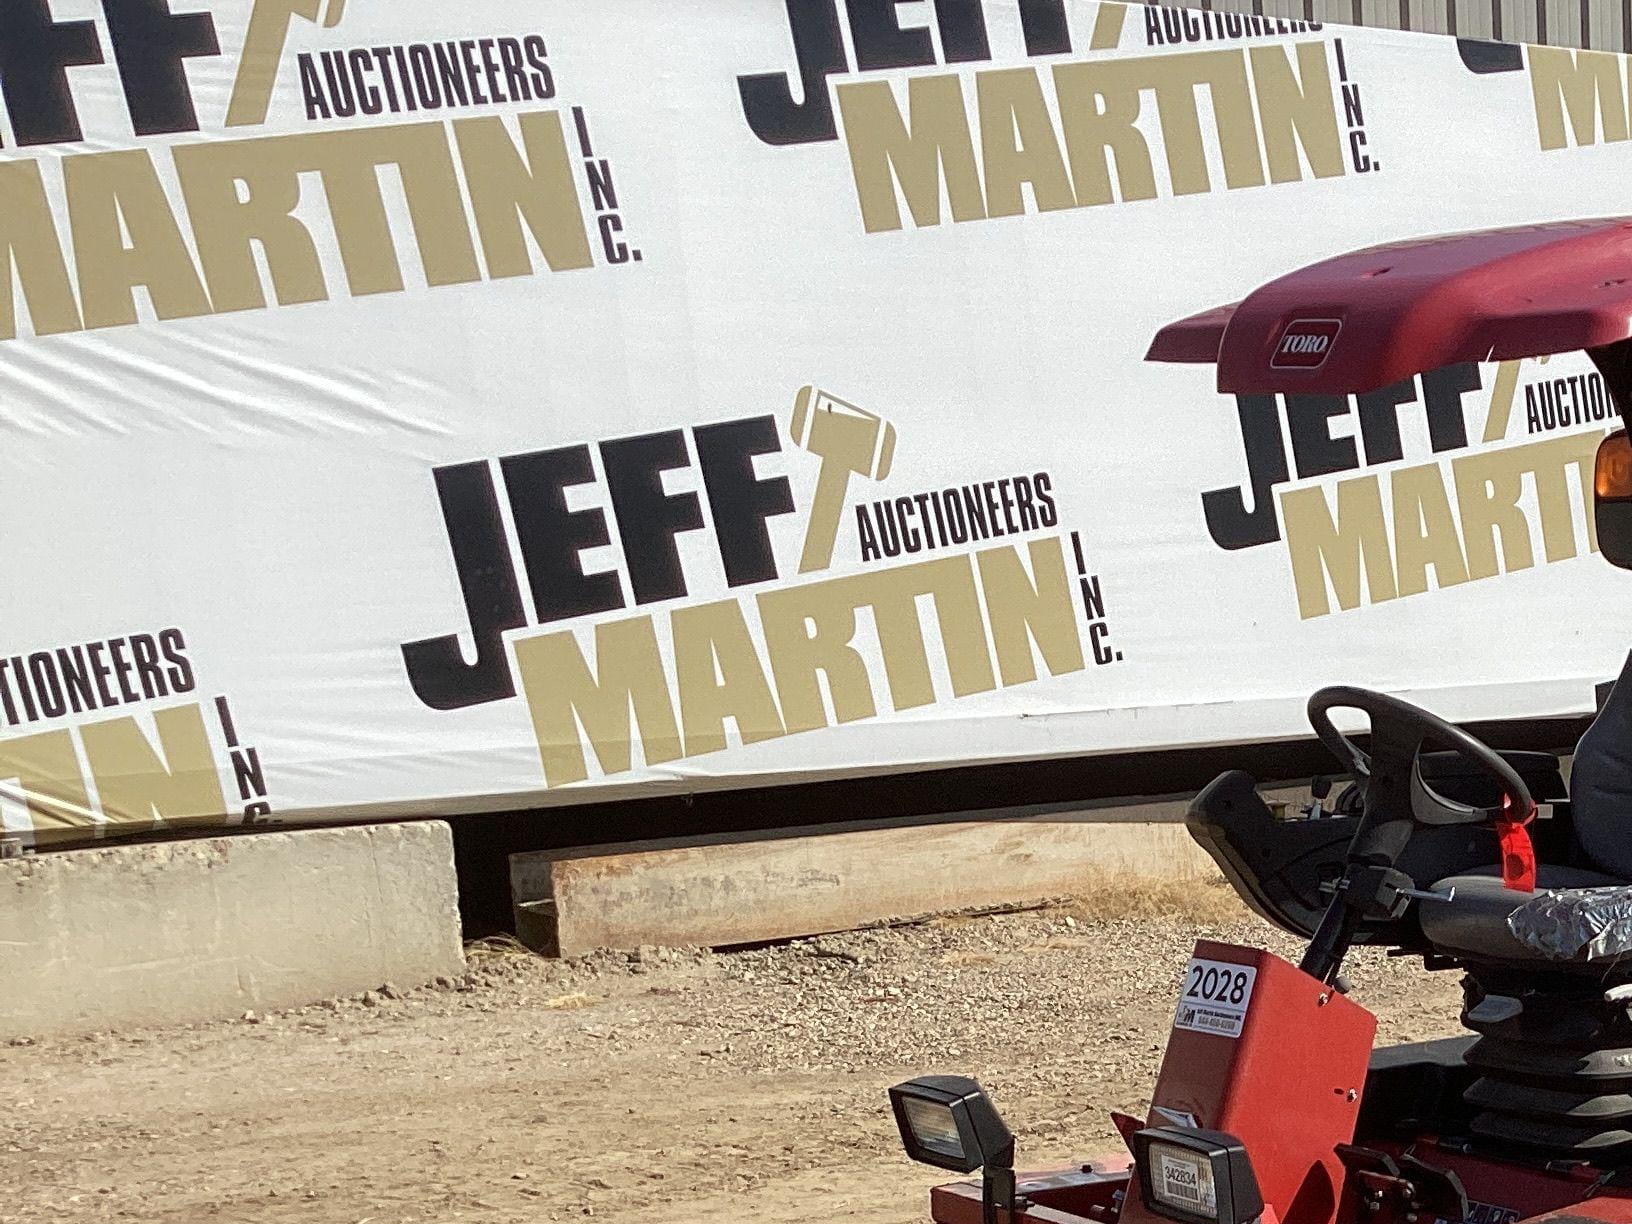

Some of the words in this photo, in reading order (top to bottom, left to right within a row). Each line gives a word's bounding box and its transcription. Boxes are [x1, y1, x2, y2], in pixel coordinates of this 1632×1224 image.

[0, 0, 221, 148] FF
[298, 35, 555, 120] AUCTIONEERS
[836, 40, 1346, 234] MARTIN
[1333, 38, 1381, 174] INC.
[572, 106, 643, 265] INC.
[1281, 334, 1329, 353] TORO
[400, 414, 797, 711] JEFF
[855, 472, 1057, 562] AUCTIONEERS
[512, 535, 1085, 789] MARTIN
[1071, 531, 1124, 666] INC.
[0, 628, 195, 725] TIONEERS
[1186, 965, 1248, 1004] 2028
